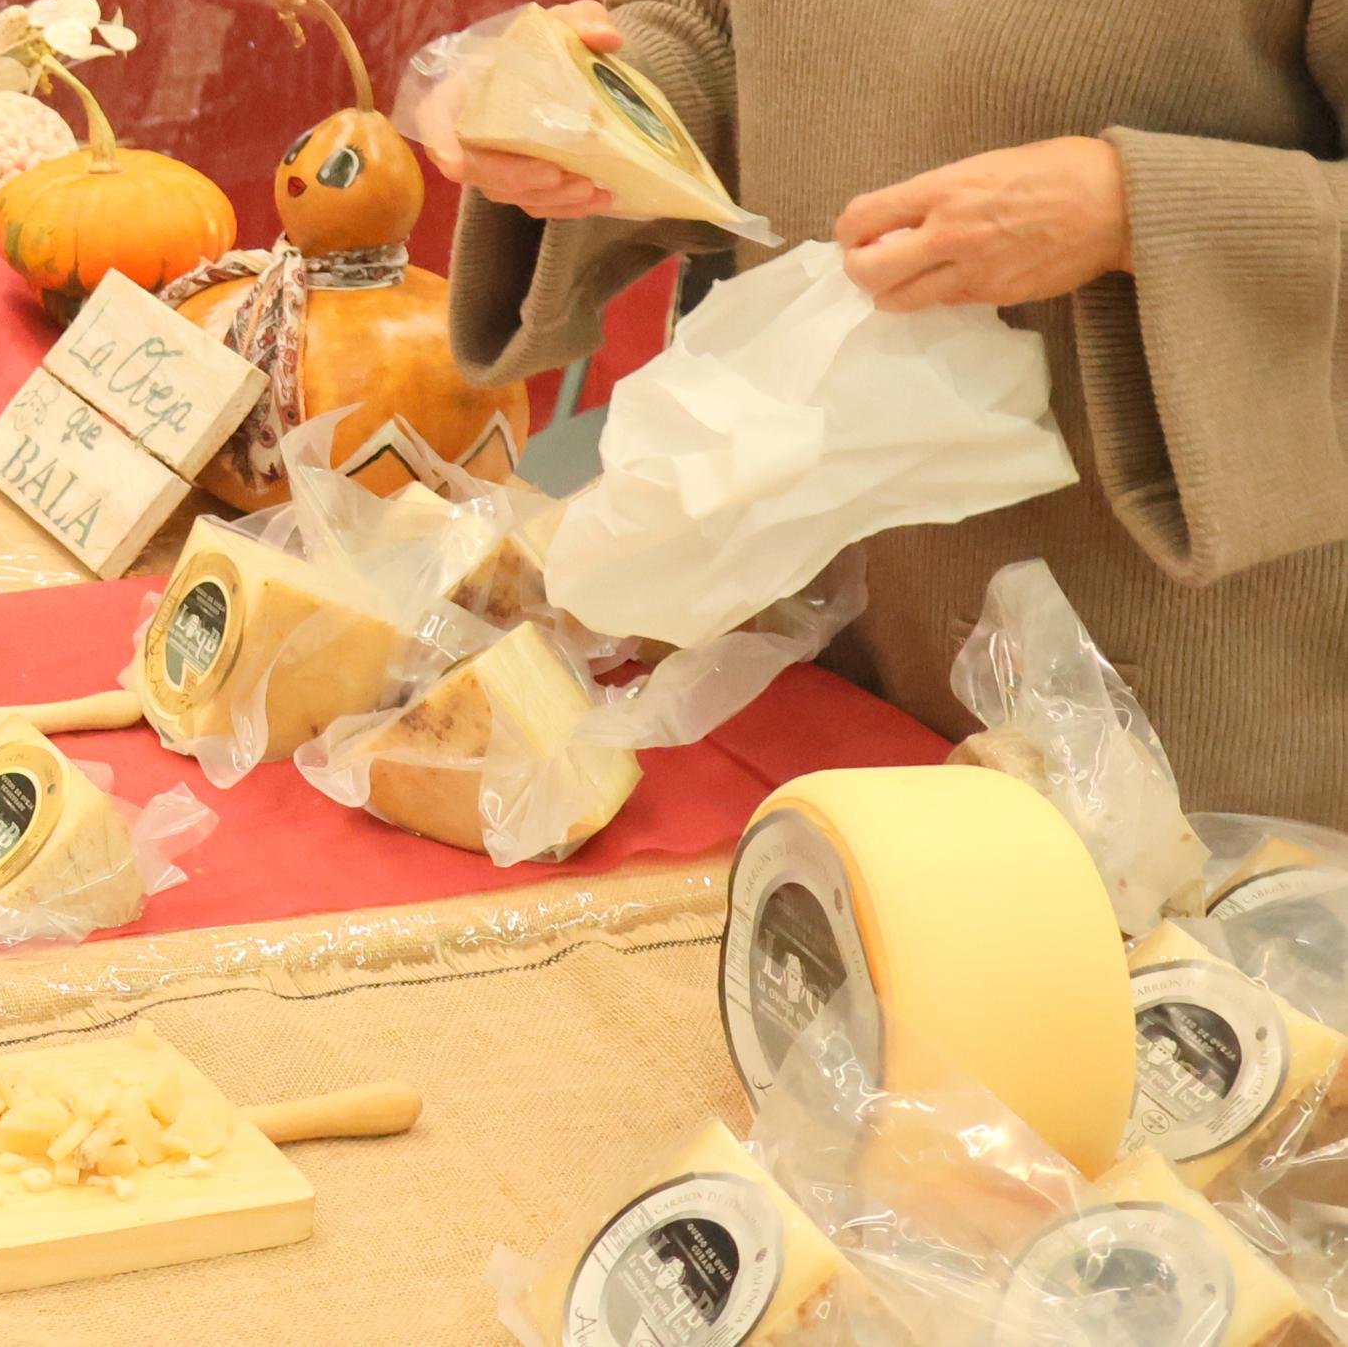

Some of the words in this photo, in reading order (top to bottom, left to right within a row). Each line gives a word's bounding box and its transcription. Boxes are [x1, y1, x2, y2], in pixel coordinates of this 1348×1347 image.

[69, 297, 112, 378] La
[107, 336, 196, 452] Oveja
[1209, 1038, 1238, 1061] OVEJA
[686, 1222, 709, 1249] QUESO
[705, 1244, 716, 1260] DE
[713, 1256, 734, 1282] OVEJA
[690, 1244, 716, 1275] CURADO
